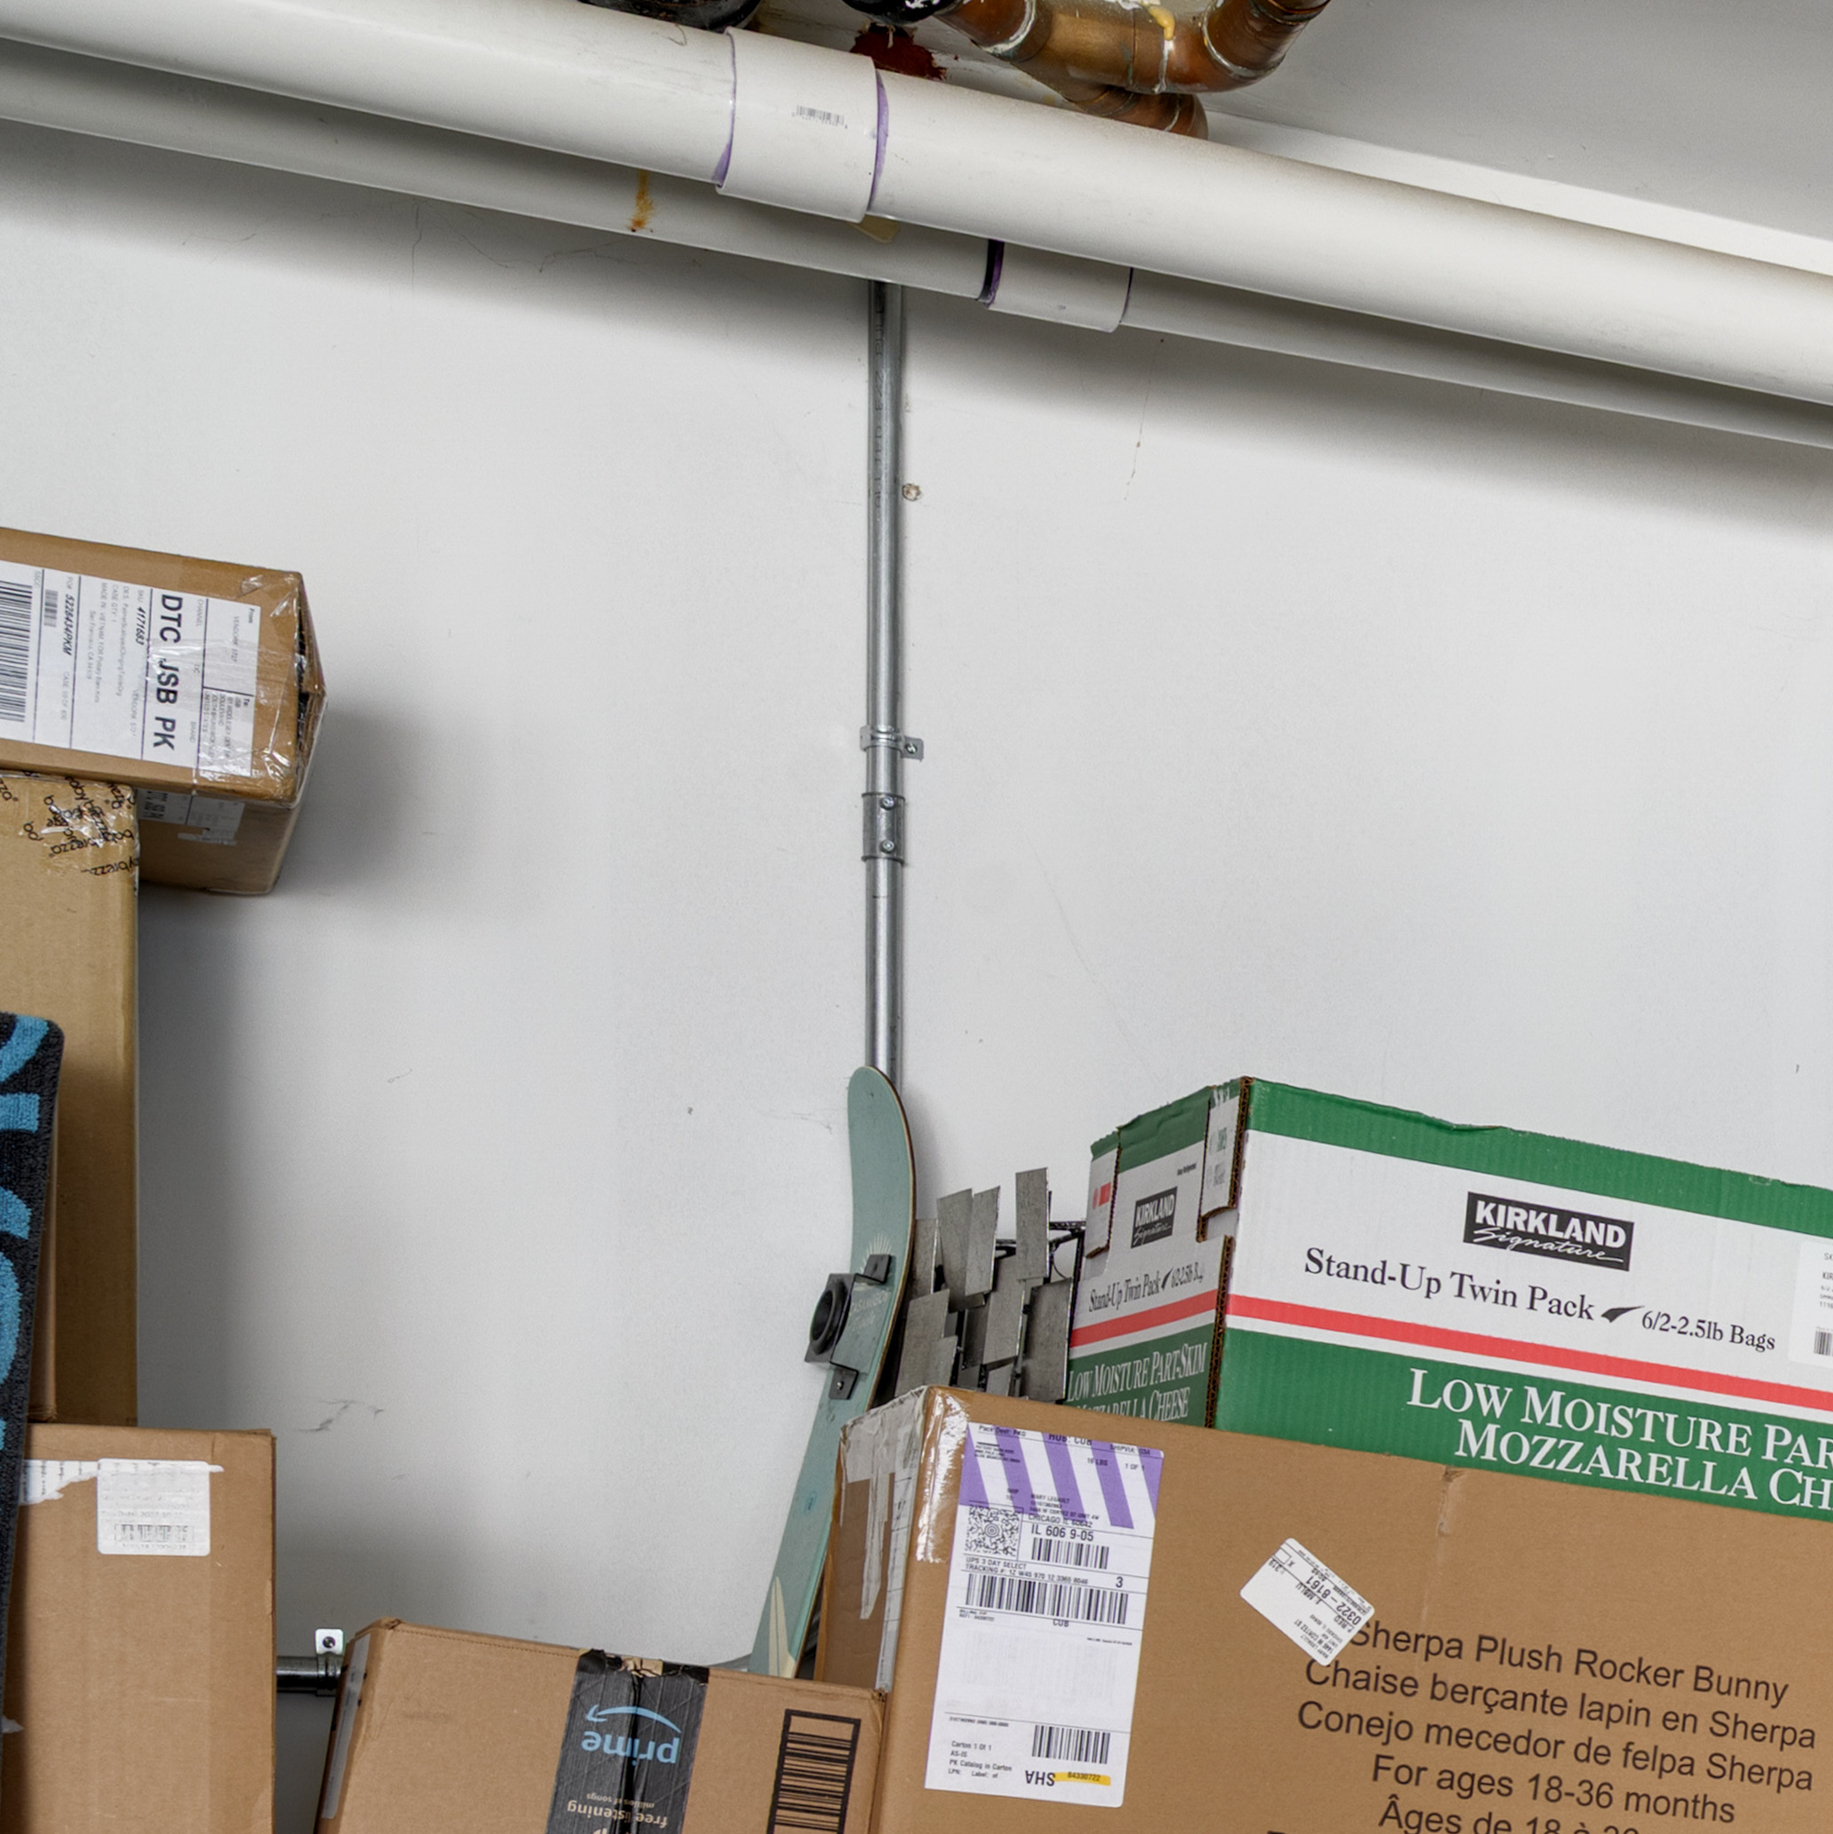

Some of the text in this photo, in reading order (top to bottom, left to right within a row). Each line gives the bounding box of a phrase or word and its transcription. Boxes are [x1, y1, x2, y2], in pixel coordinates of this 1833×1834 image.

[153, 594, 183, 749] DTC JSB PK
[1135, 1193, 1175, 1227] KIRKLAND
[1475, 1200, 1629, 1251] KIRKLAND
[1472, 1225, 1625, 1264] Signature
[1088, 1270, 1162, 1312] Stand-Up Twin Pack
[1304, 1247, 1593, 1320] Stand-Up Twin Pack
[1641, 1310, 1775, 1352] 6/2-2.5lb Bags
[1066, 1341, 1207, 1402] LOW MOISTURE PART-SKIM
[1149, 1387, 1189, 1420] CHEESE
[1407, 1367, 1512, 1413] LOW
[1520, 1385, 1752, 1456] MOISTURE
[1454, 1418, 1758, 1499] MOZZARELLA
[1030, 1523, 1093, 1541] IL 606 9-05
[965, 1556, 1026, 1569] UPS 3 DAY SELECT
[1115, 1575, 1123, 1588] 3
[1305, 1575, 1361, 1625] 0322 8161
[1350, 1619, 1789, 1709] Sherpa Plush Rocker Bunny
[1305, 1658, 1815, 1751] Chaise berçante lapin en Sherpa
[580, 1730, 681, 1766] prime
[951, 1740, 971, 1748] Carton
[959, 1759, 982, 1769] Catalog
[991, 1763, 1012, 1771] Carton
[1297, 1700, 1812, 1793] Conejo mecedor de felpa Sherpa
[1372, 1755, 1734, 1823] For ages 18-36 months
[634, 1809, 667, 1828] free
